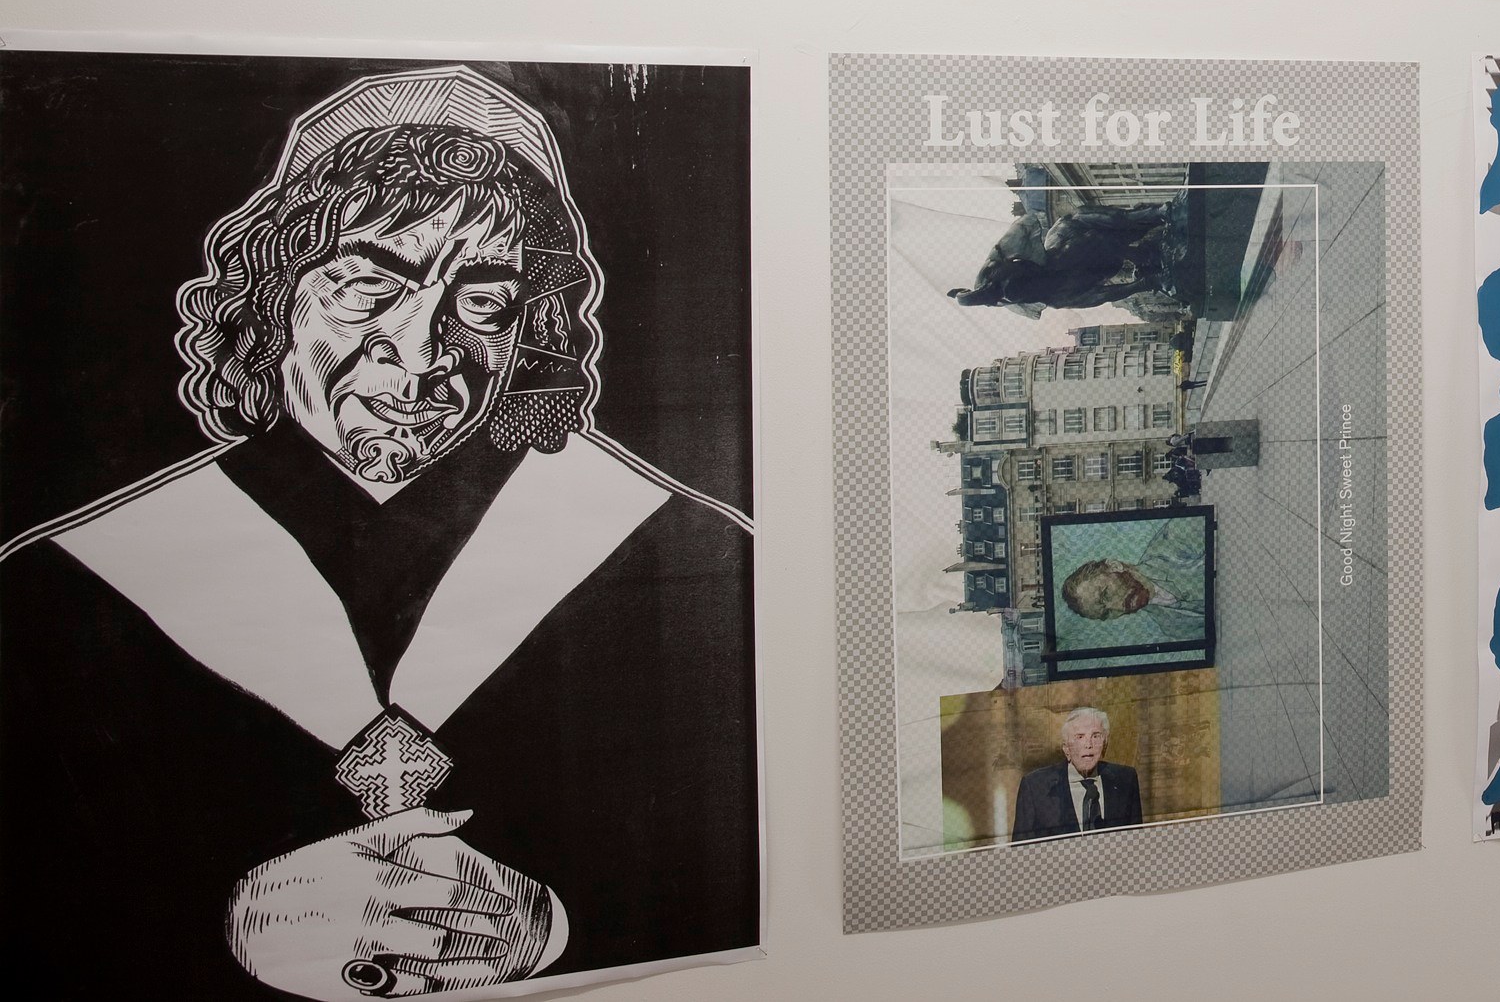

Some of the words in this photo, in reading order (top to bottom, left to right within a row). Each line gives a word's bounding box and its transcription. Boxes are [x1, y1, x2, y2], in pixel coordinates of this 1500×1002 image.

[923, 94, 1061, 147] Lust
[1080, 92, 1172, 147] for
[1193, 93, 1301, 147] Life
[1339, 404, 1352, 450] Prince
[1340, 454, 1352, 499] Sweet
[1340, 503, 1356, 542] Night
[1340, 549, 1354, 586] Good
